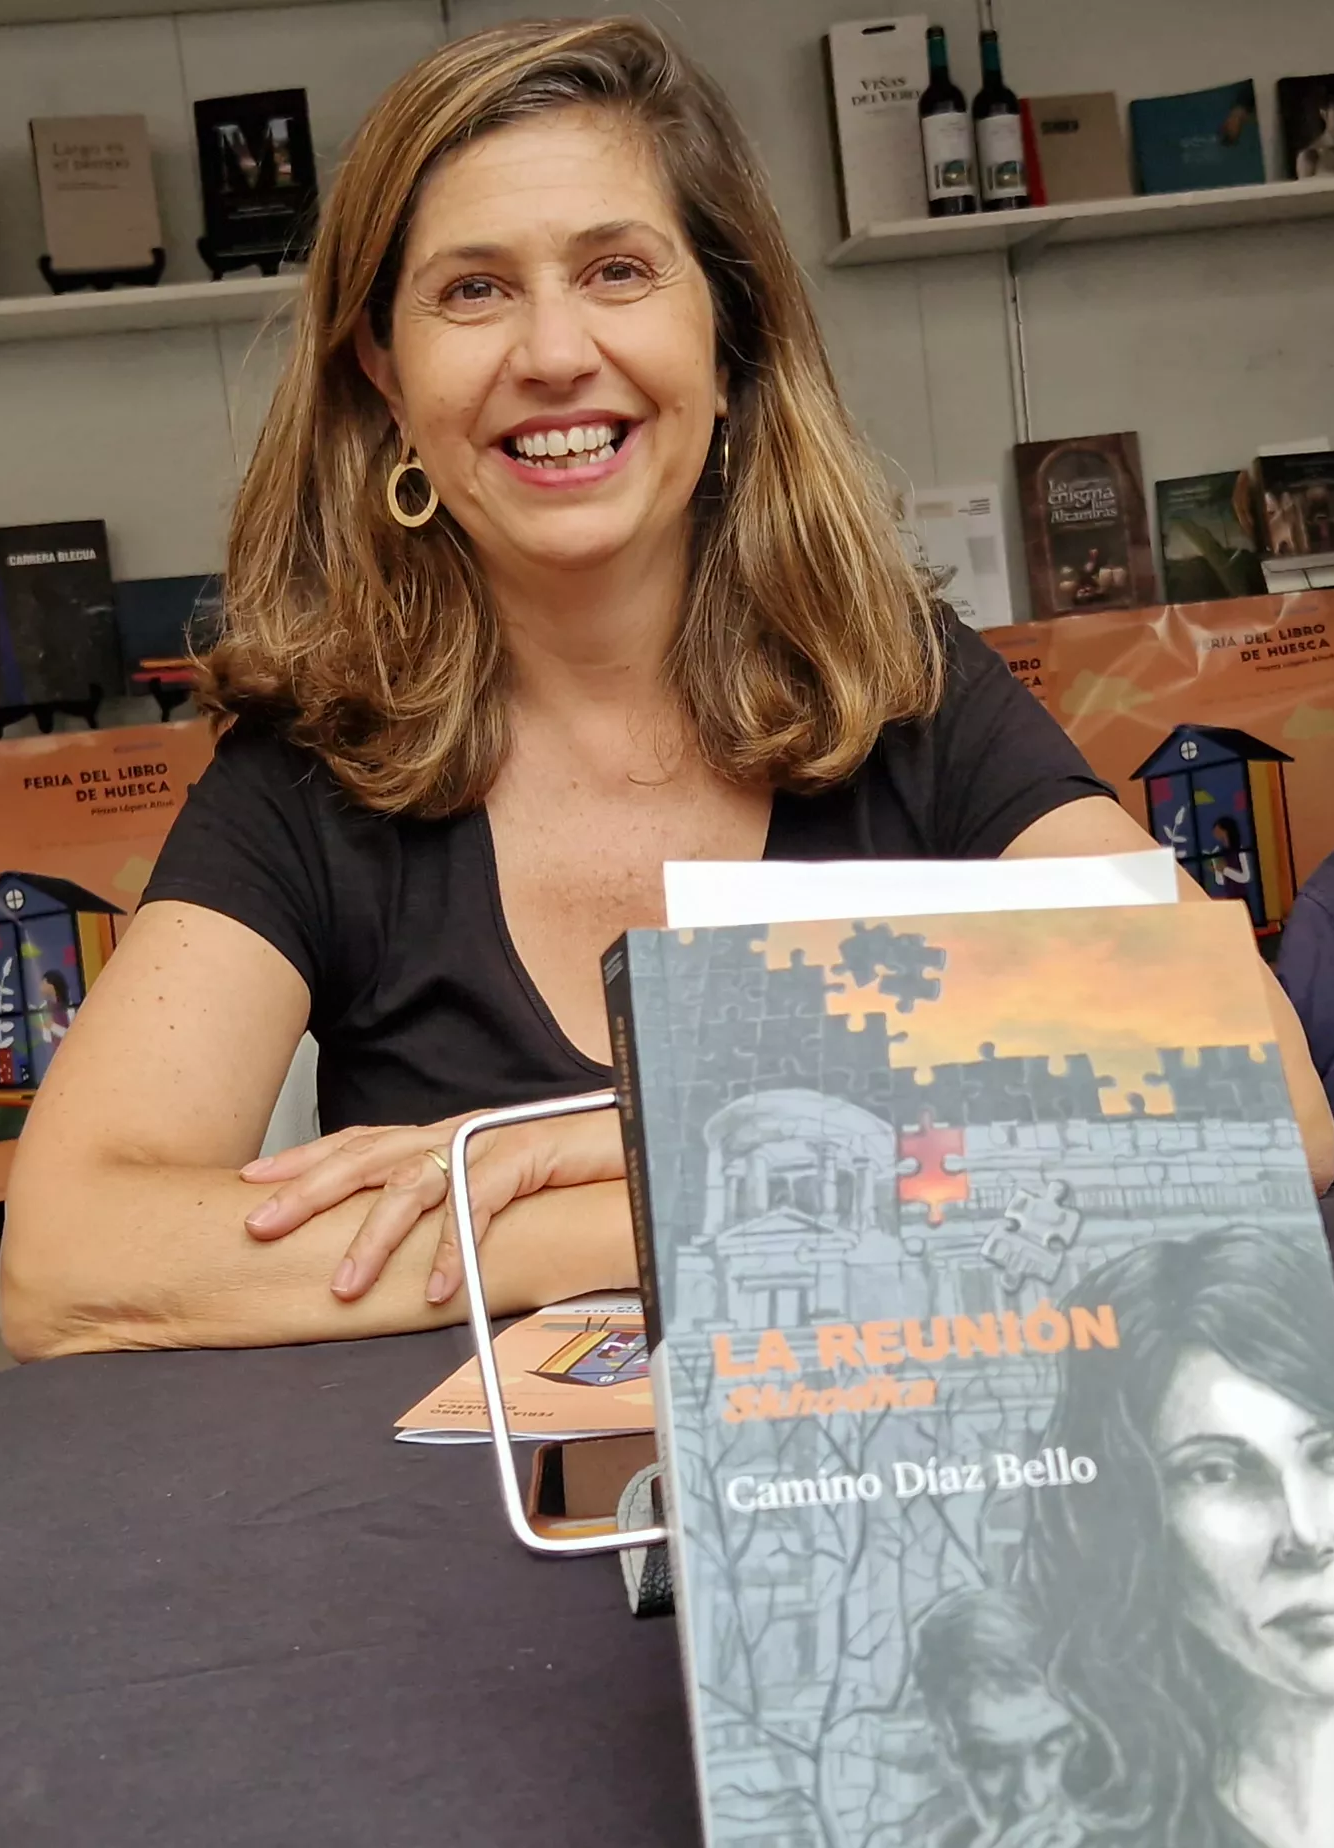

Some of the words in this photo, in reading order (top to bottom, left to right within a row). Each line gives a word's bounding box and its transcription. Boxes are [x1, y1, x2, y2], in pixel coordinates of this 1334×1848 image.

[1243, 632, 1273, 645] DEL
[1278, 624, 1326, 641] LIBRO
[1240, 650, 1261, 662] DE
[1266, 638, 1331, 658] HUESCA
[23, 774, 73, 790] FERIA
[79, 769, 111, 784] DEL
[118, 763, 168, 781] LIBRO
[75, 789, 98, 803] DE
[104, 780, 171, 799] HUESCA
[712, 1330, 801, 1377] LA
[816, 1299, 1120, 1369] REUNIÓN
[726, 1470, 883, 1513] Camino
[893, 1456, 986, 1498] Díaz
[994, 1446, 1099, 1491] Bello
